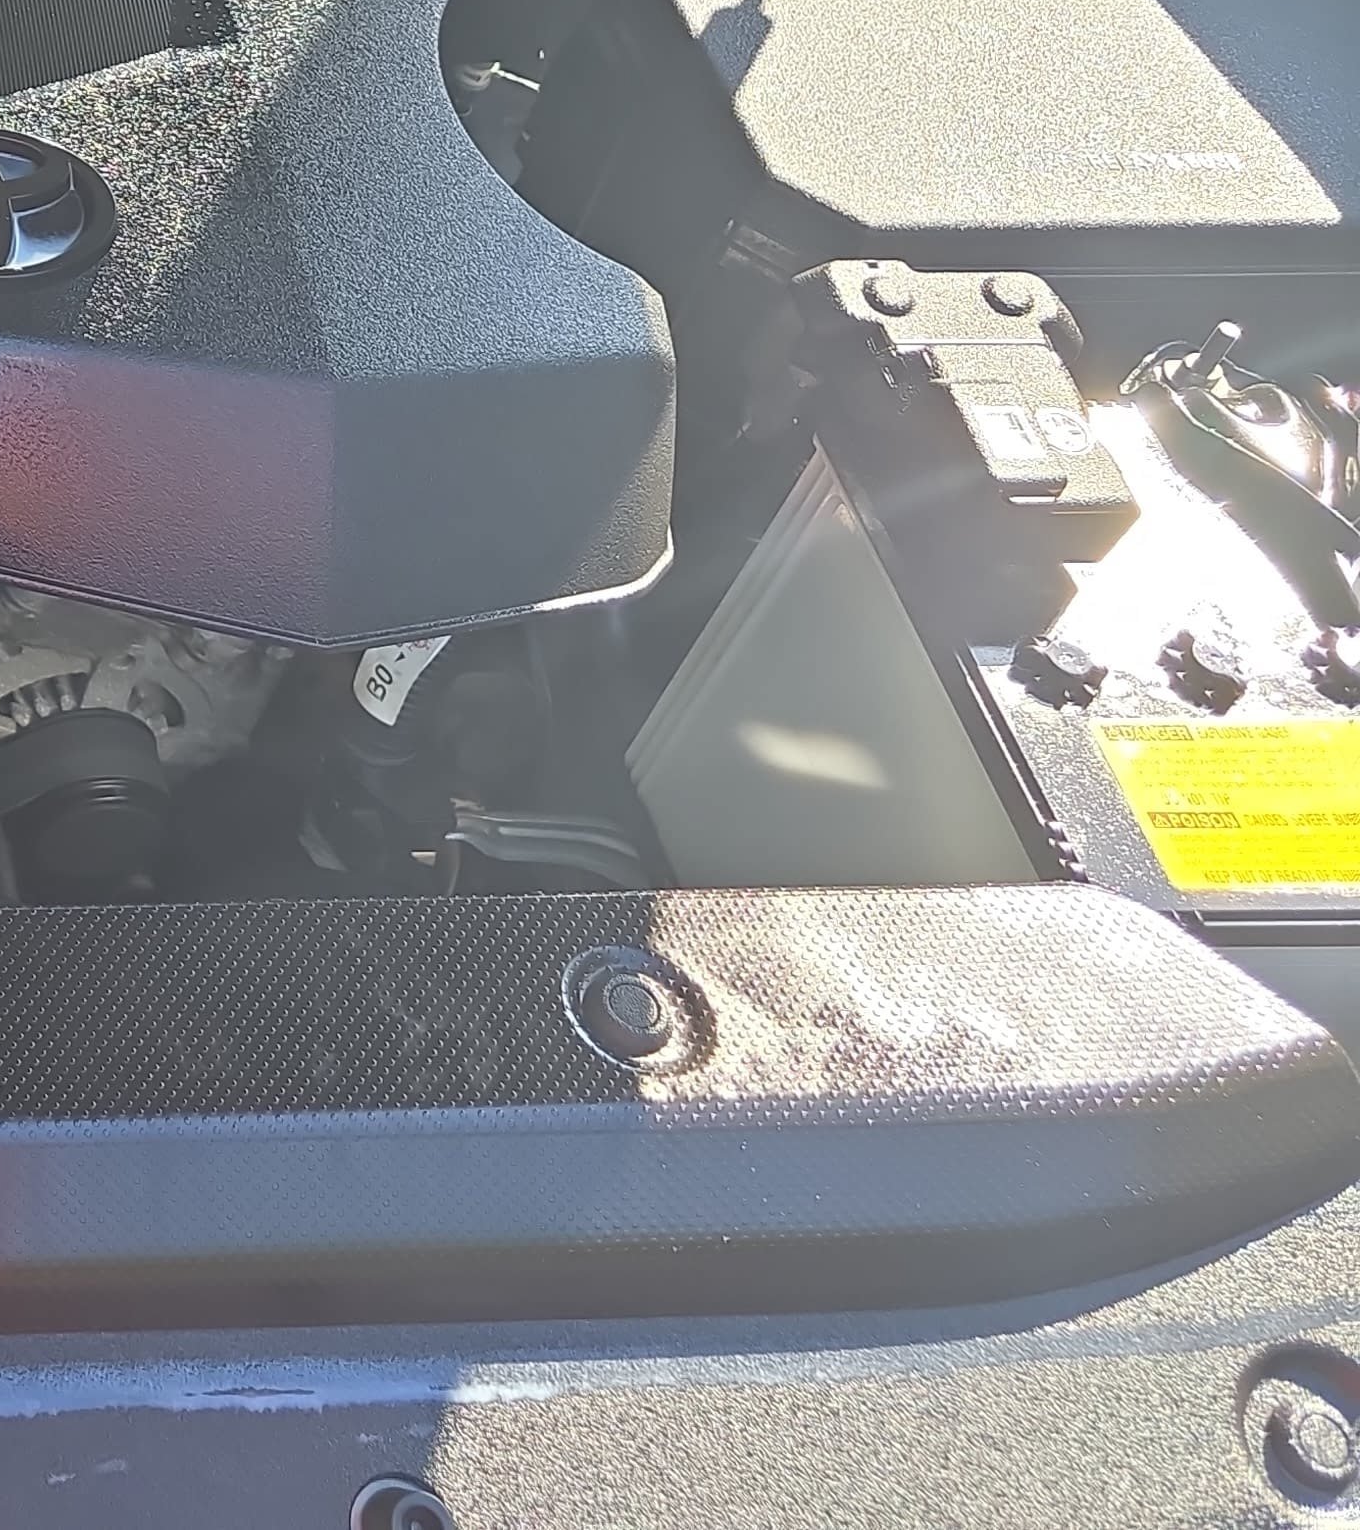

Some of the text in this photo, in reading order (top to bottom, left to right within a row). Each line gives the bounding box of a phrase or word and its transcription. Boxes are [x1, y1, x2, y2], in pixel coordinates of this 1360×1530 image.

[1121, 726, 1192, 741] DANGER
[1169, 813, 1240, 828] POISON
[1203, 870, 1231, 883] KEEP
[1233, 870, 1256, 883] OUT
[1261, 870, 1275, 883] OF
[1277, 870, 1315, 883] REACH
